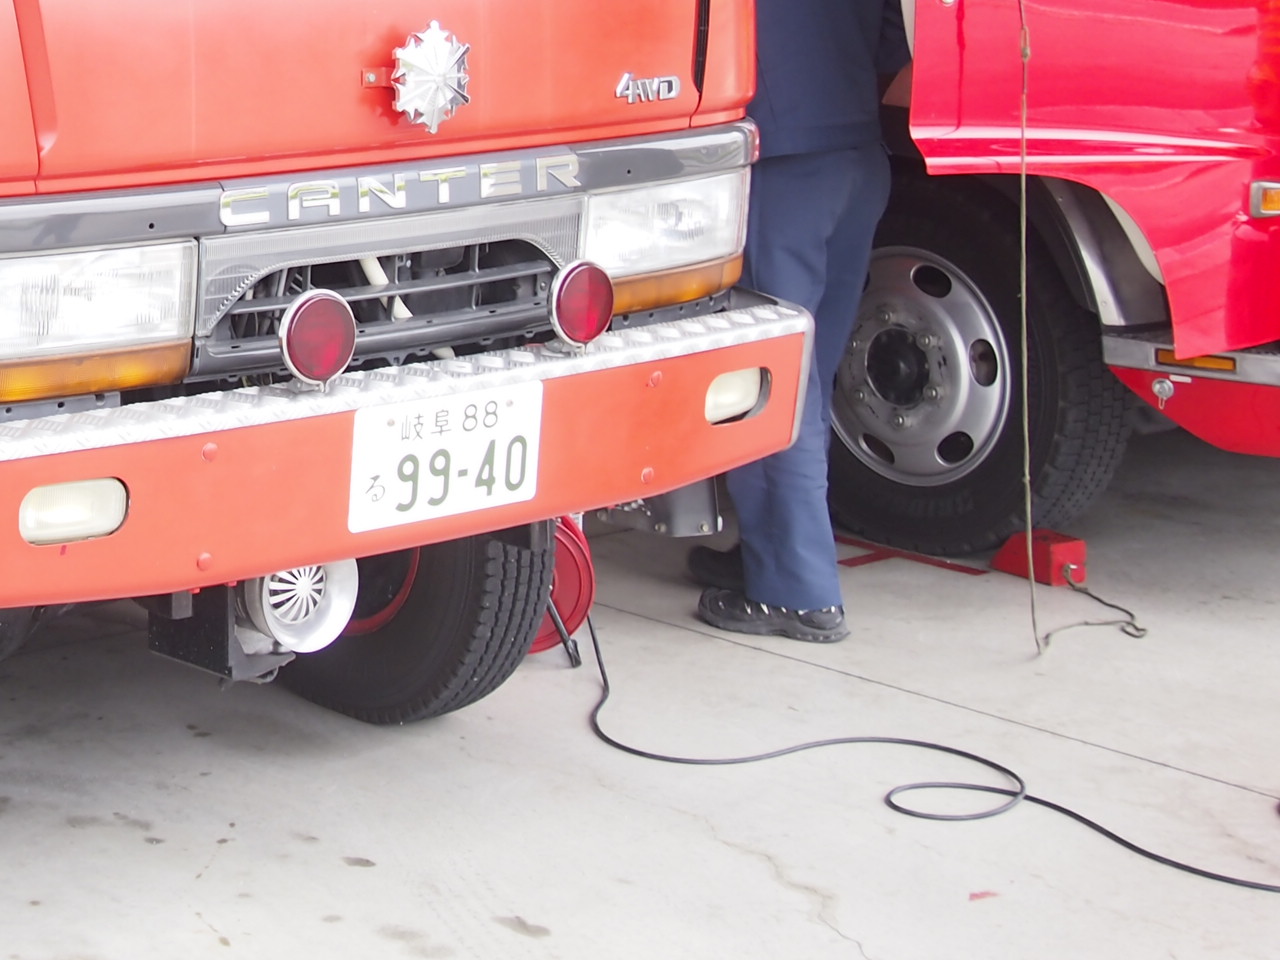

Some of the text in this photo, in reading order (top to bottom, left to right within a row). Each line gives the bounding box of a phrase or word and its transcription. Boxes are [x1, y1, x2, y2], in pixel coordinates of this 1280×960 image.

[616, 72, 681, 104] 4WD
[219, 154, 582, 226] CANTER
[400, 400, 498, 441] 岐阜 88
[365, 434, 528, 512] る 99-40
